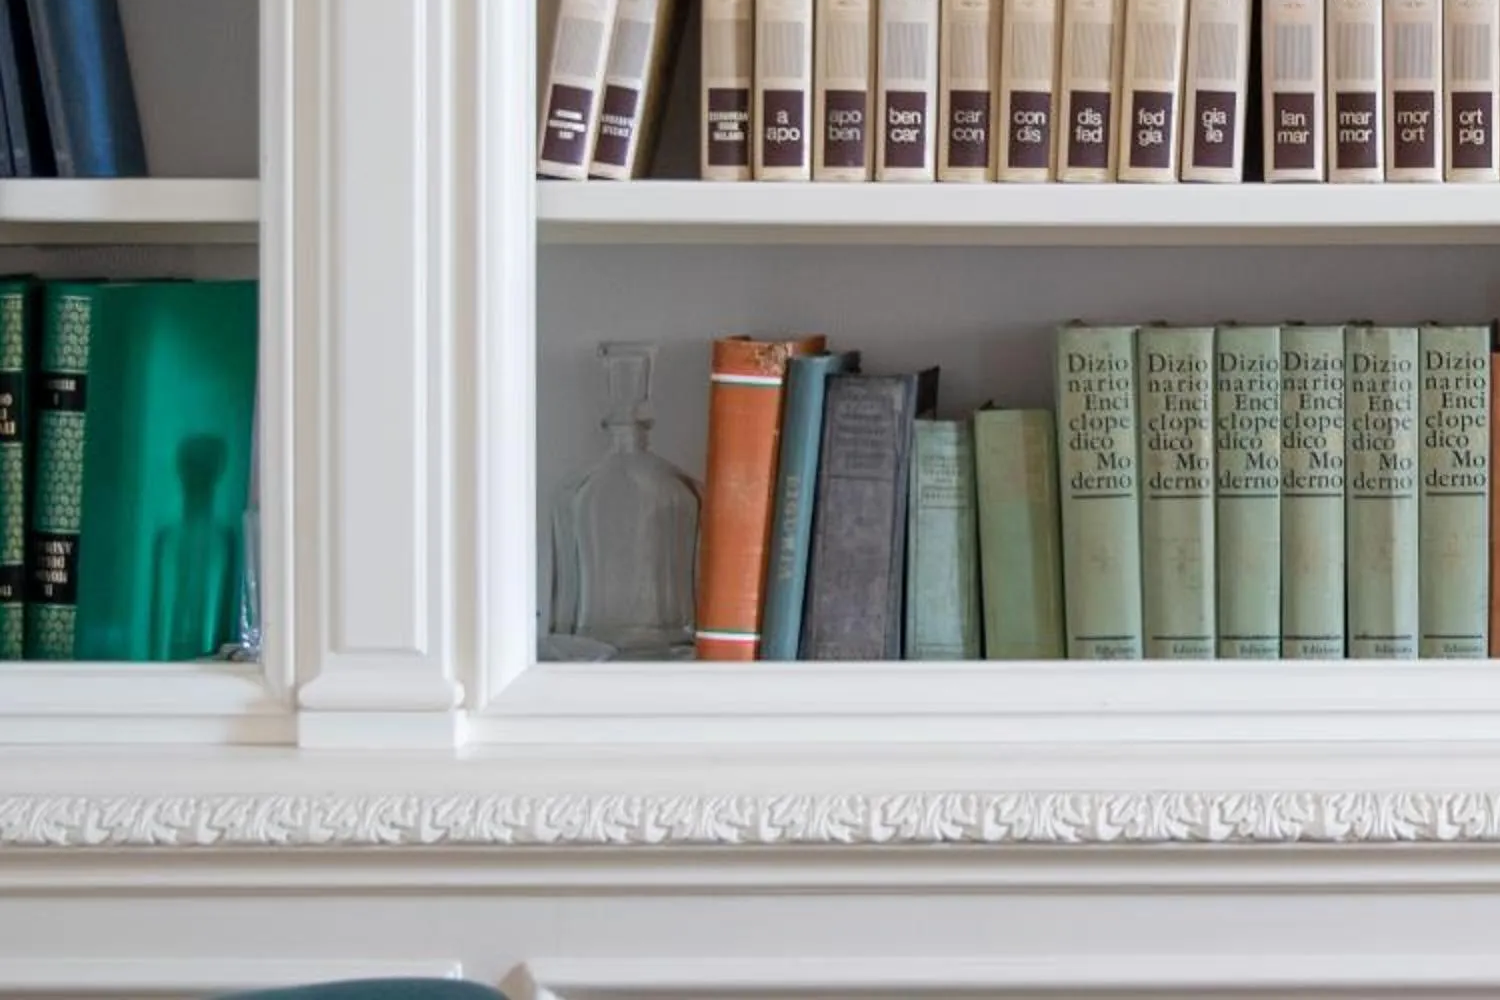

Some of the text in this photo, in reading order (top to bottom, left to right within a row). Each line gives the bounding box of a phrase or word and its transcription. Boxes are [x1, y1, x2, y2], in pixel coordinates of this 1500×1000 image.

[777, 112, 788, 123] a
[829, 109, 862, 127] apo
[889, 108, 921, 125] ben
[954, 110, 983, 125] car
[1014, 111, 1046, 126] con
[1077, 108, 1101, 126] dis
[1137, 109, 1164, 126] fed
[1202, 108, 1227, 126] gia
[1339, 111, 1372, 125] mar
[1398, 109, 1430, 124] mor
[1459, 110, 1483, 125] ort
[767, 126, 799, 144] apo
[828, 125, 860, 141] ben
[891, 127, 920, 143] car
[952, 128, 985, 143] con
[1016, 126, 1041, 143] dis
[1075, 125, 1103, 143] fed
[1138, 127, 1162, 146] gia
[1277, 128, 1309, 144] mar
[1339, 128, 1371, 143] mor
[1402, 126, 1425, 142] ort
[1459, 126, 1484, 145] pig
[1067, 353, 1128, 373] Dizio
[1148, 353, 1208, 373] Dizio
[1219, 353, 1279, 373] Dizio
[1283, 351, 1343, 372] Dizio
[1353, 353, 1411, 373] Dizio
[1426, 350, 1485, 371] Dizio
[1068, 376, 1129, 392] nario
[1148, 377, 1208, 393] nario
[1219, 375, 1279, 392] nario
[1283, 375, 1344, 391] nario
[1353, 377, 1412, 393] nario
[1425, 374, 1486, 391] nario
[1085, 394, 1130, 411] Enci
[1165, 394, 1208, 411] Enci
[1235, 393, 1280, 411] Enci
[1300, 393, 1344, 411] Enci
[1369, 395, 1412, 412] Enci
[1441, 393, 1486, 410] Enci
[1069, 414, 1131, 434] clope
[1149, 414, 1209, 434] clope
[1219, 414, 1280, 433] clope
[1283, 413, 1344, 433] clope
[1353, 414, 1412, 434] clope
[1426, 411, 1486, 431] clope
[1069, 432, 1114, 451] dico
[1149, 432, 1193, 451] dico
[1219, 432, 1263, 450] dico
[1283, 432, 1327, 449] dico
[1353, 433, 1395, 451] dico
[1426, 429, 1469, 449] dico
[1099, 455, 1131, 470] Mo
[1176, 454, 1209, 471] Mo
[1246, 452, 1279, 470] Mo
[1309, 452, 1343, 470] Mo
[1379, 455, 1412, 471] Mo
[1452, 451, 1486, 469] Mo
[1072, 472, 1132, 490] derno
[1150, 472, 1210, 490] derno
[1219, 471, 1279, 489] derno
[1283, 470, 1343, 488] derno
[1353, 472, 1412, 490] derno
[1426, 470, 1486, 488] derno
